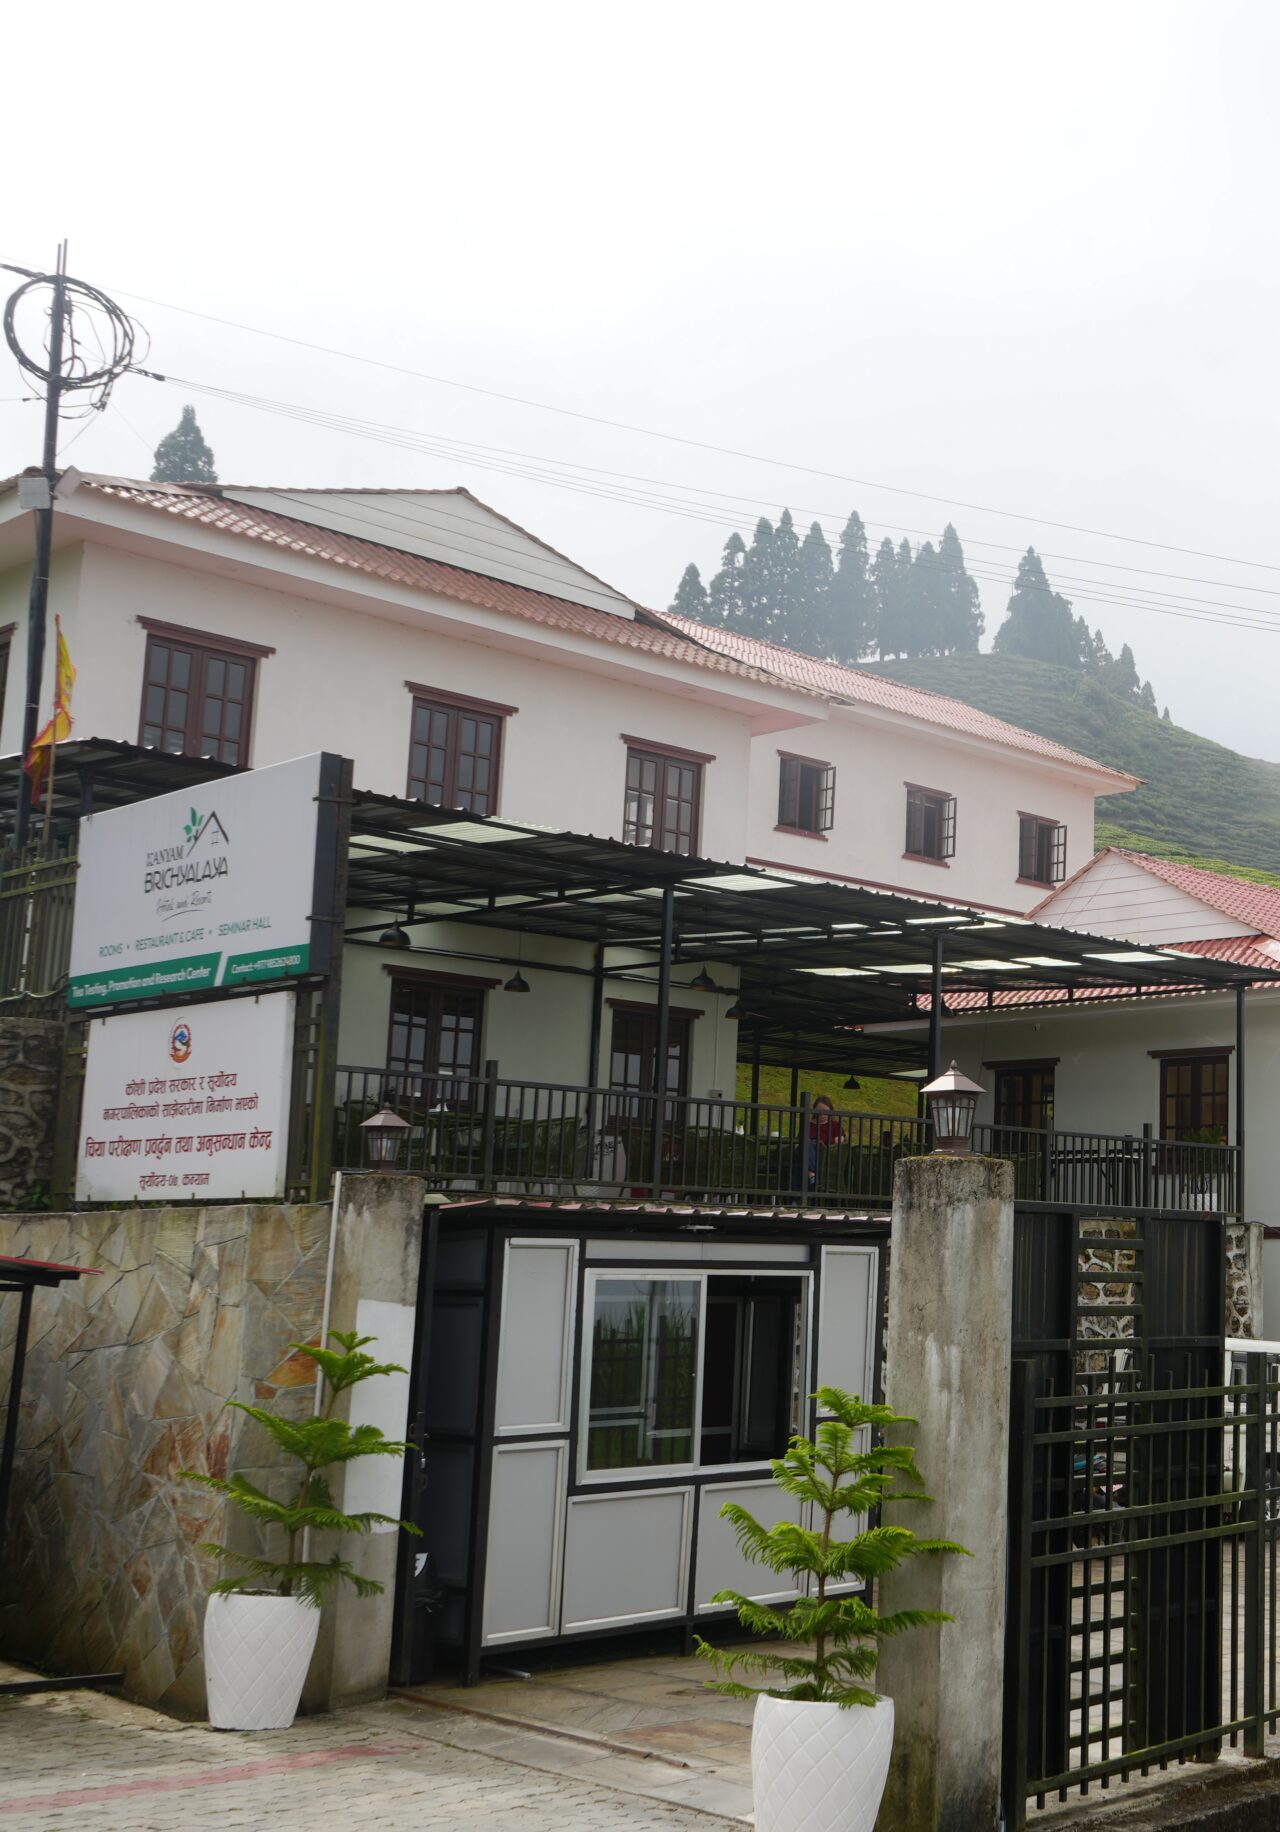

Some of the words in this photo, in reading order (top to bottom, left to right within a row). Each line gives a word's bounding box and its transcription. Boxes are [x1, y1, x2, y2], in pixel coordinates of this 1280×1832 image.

[98, 943, 123, 957] ROOMS
[135, 932, 178, 951] RESTAURANT
[185, 928, 205, 942] CAFE
[218, 919, 251, 936] SEMINAR
[252, 916, 272, 930] HALL
[72, 986, 84, 998] Tea
[108, 977, 141, 991] Promotion
[142, 973, 155, 986] and
[155, 968, 185, 984] Research
[186, 966, 212, 980] Center
[148, 1077, 167, 1096] प्रदेश
[168, 1076, 198, 1093] सरकार
[199, 1076, 206, 1091] र
[205, 1096, 233, 1114] निर्माण
[85, 1136, 106, 1158] चिया
[108, 1135, 142, 1158] परीक्षण
[175, 1136, 194, 1154] तथा
[196, 1133, 247, 1156] अनुसन्धान
[248, 1127, 273, 1151] केन्द्र
